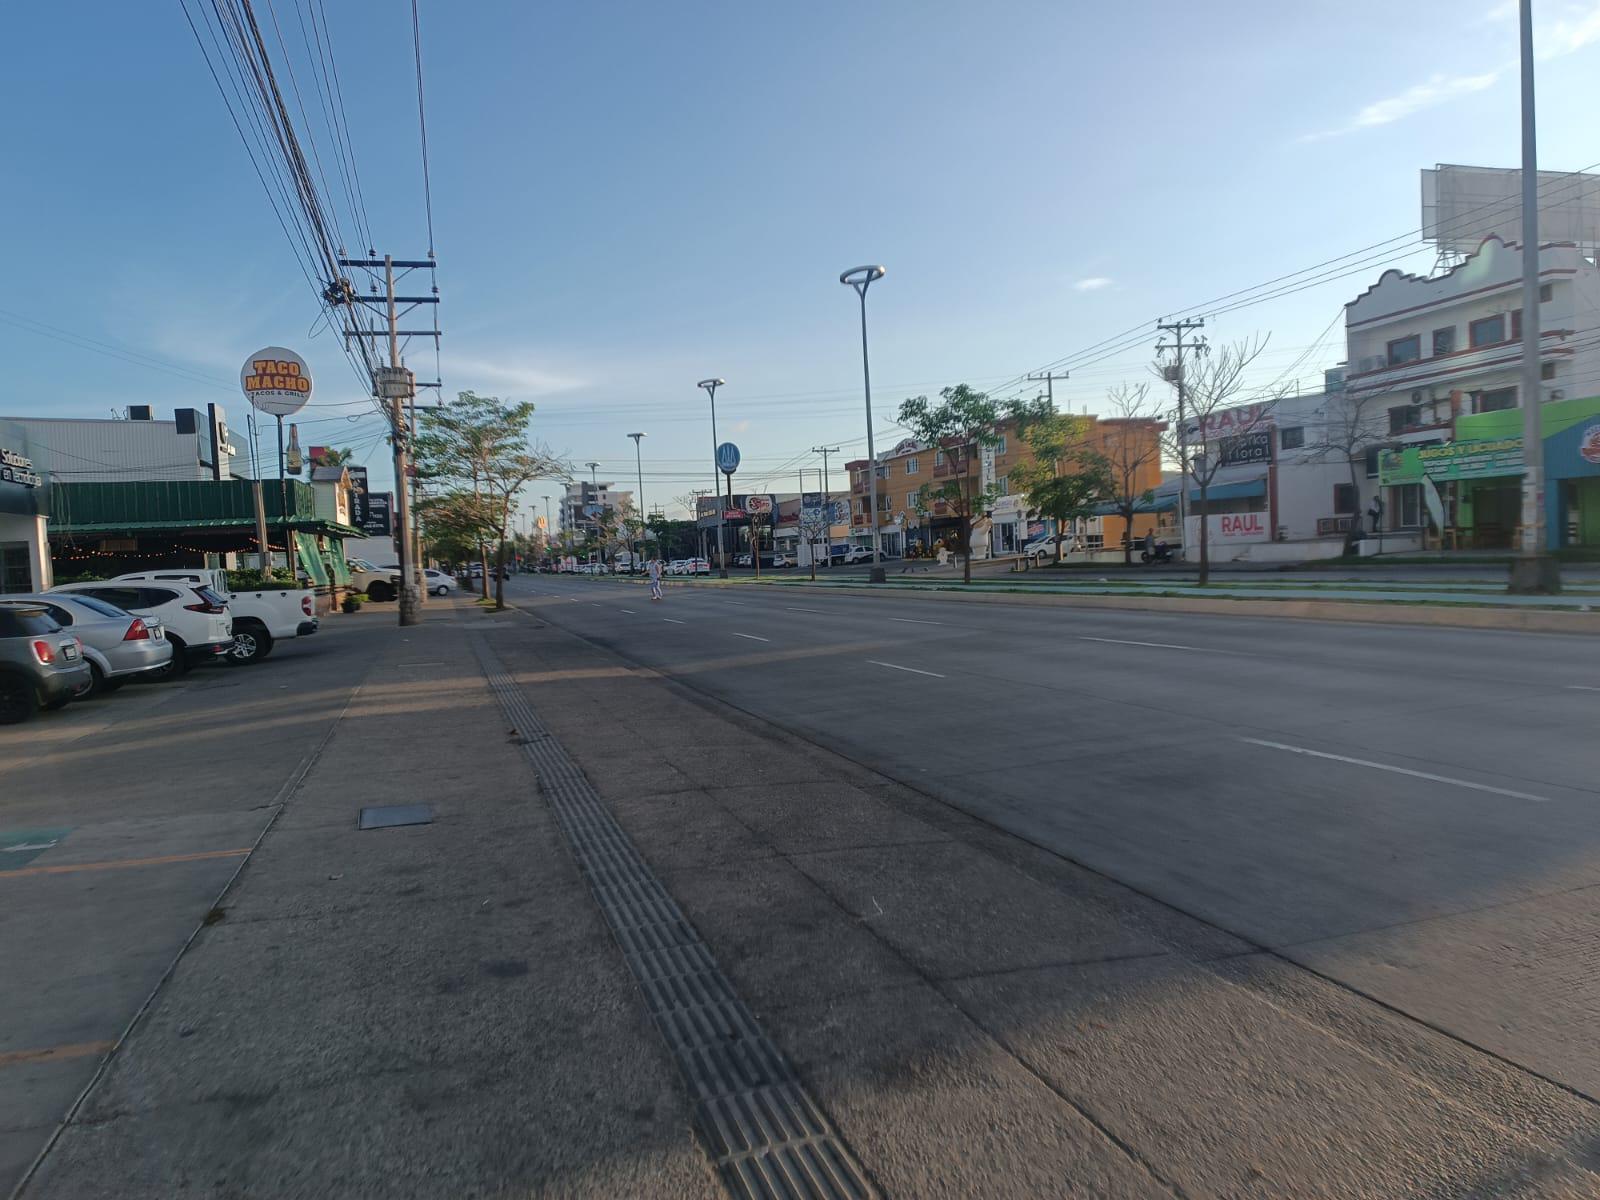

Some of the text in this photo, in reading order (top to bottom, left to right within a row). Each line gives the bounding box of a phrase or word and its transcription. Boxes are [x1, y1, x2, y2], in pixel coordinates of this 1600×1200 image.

[253, 359, 300, 377] TACO
[246, 376, 309, 392] MACHO
[1199, 403, 1275, 433] RAUL
[1417, 446, 1456, 459] JUGOS
[1221, 514, 1264, 532] RAUL
